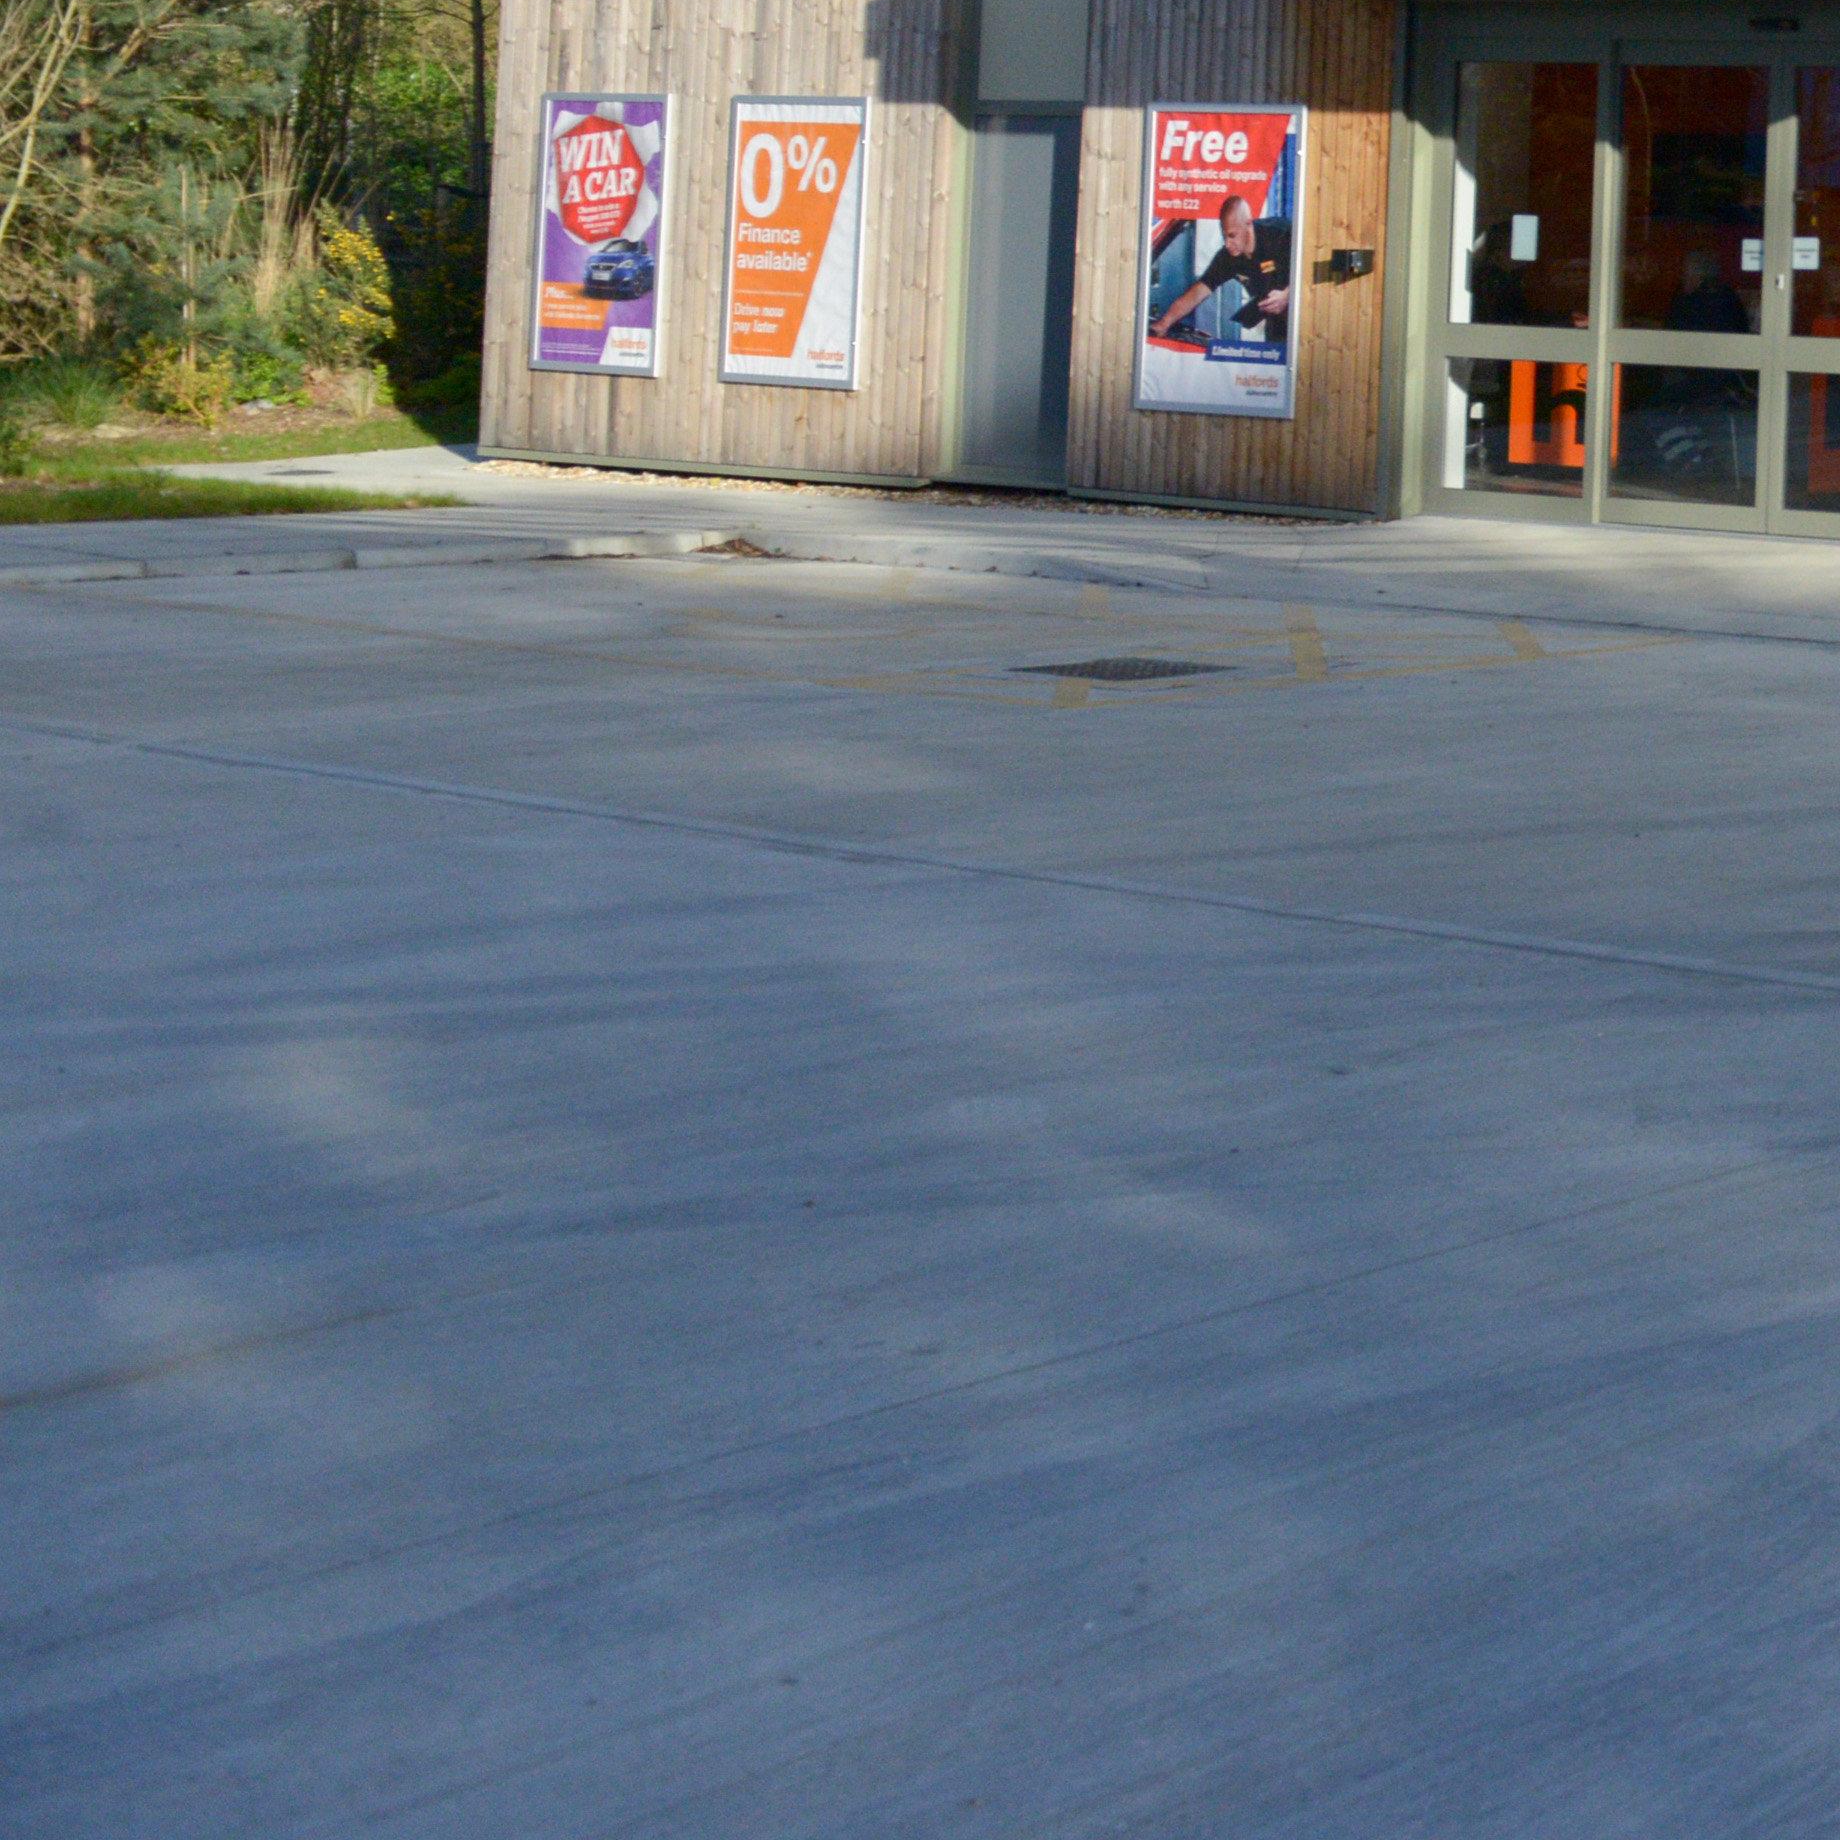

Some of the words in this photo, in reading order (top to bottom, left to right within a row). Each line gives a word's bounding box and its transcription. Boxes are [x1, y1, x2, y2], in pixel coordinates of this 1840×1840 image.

[558, 129, 625, 173] WIN
[1160, 120, 1249, 163] Free
[562, 175, 582, 204] A
[584, 167, 638, 201] CAR
[741, 133, 838, 218] 0%
[738, 222, 801, 245] Finance
[733, 321, 750, 334] pay
[753, 319, 779, 333] later
[734, 302, 760, 316] Drive
[762, 306, 785, 318] now
